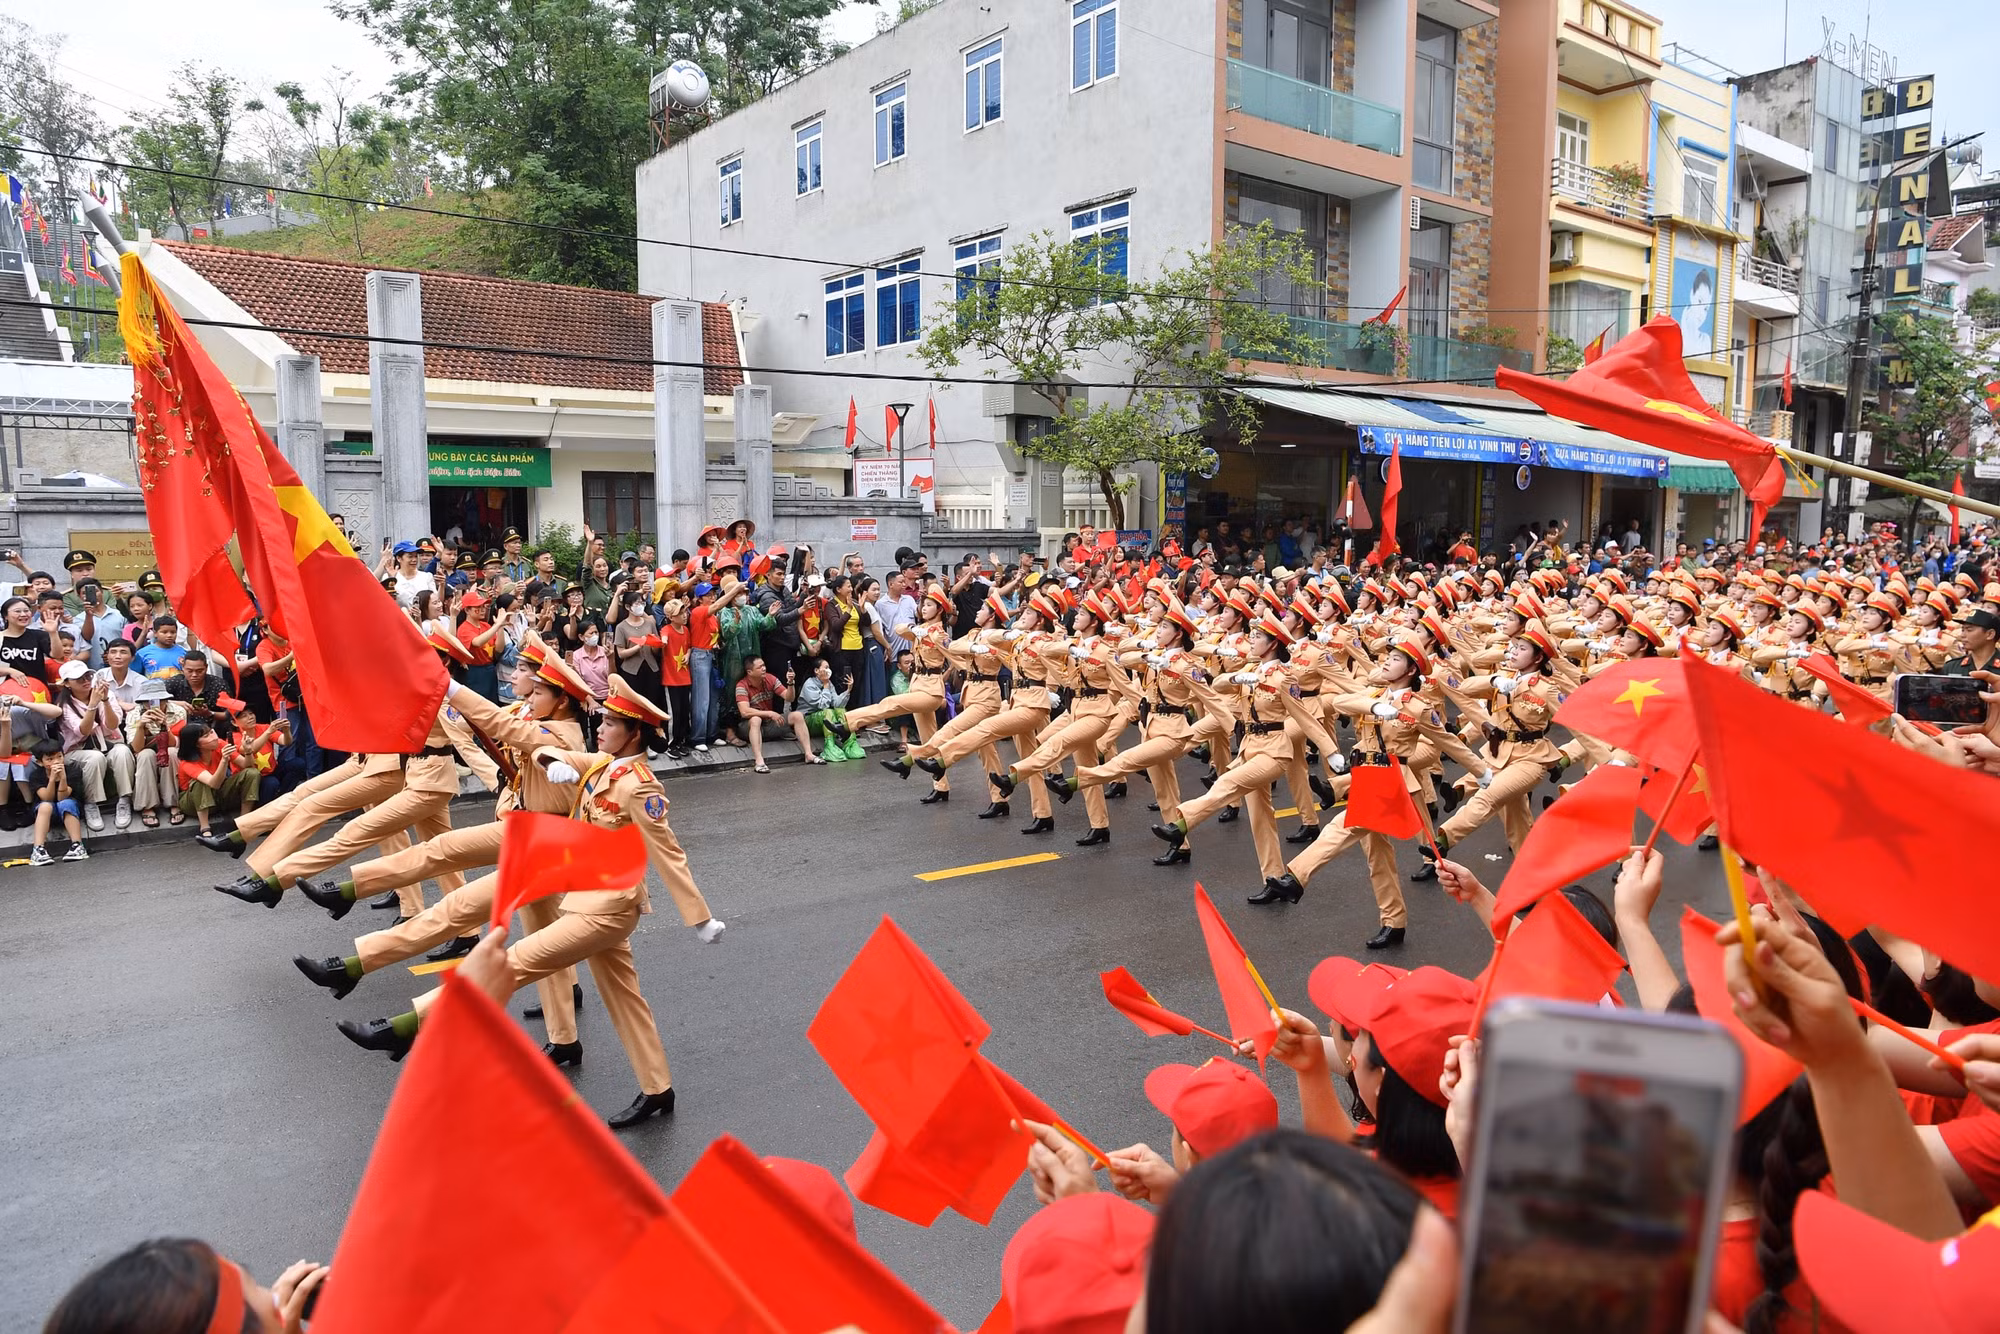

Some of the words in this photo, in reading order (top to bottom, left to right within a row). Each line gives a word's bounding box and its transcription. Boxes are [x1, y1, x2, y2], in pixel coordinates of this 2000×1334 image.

[1820, 15, 1898, 95] X-MEN
[1405, 433, 1428, 447] HÀNG
[1467, 440, 1477, 450] A1
[1480, 440, 1499, 453] VINH
[429, 452, 448, 462] ƯNG
[469, 452, 489, 463] CÁC
[107, 548, 131, 556] CHIẾN
